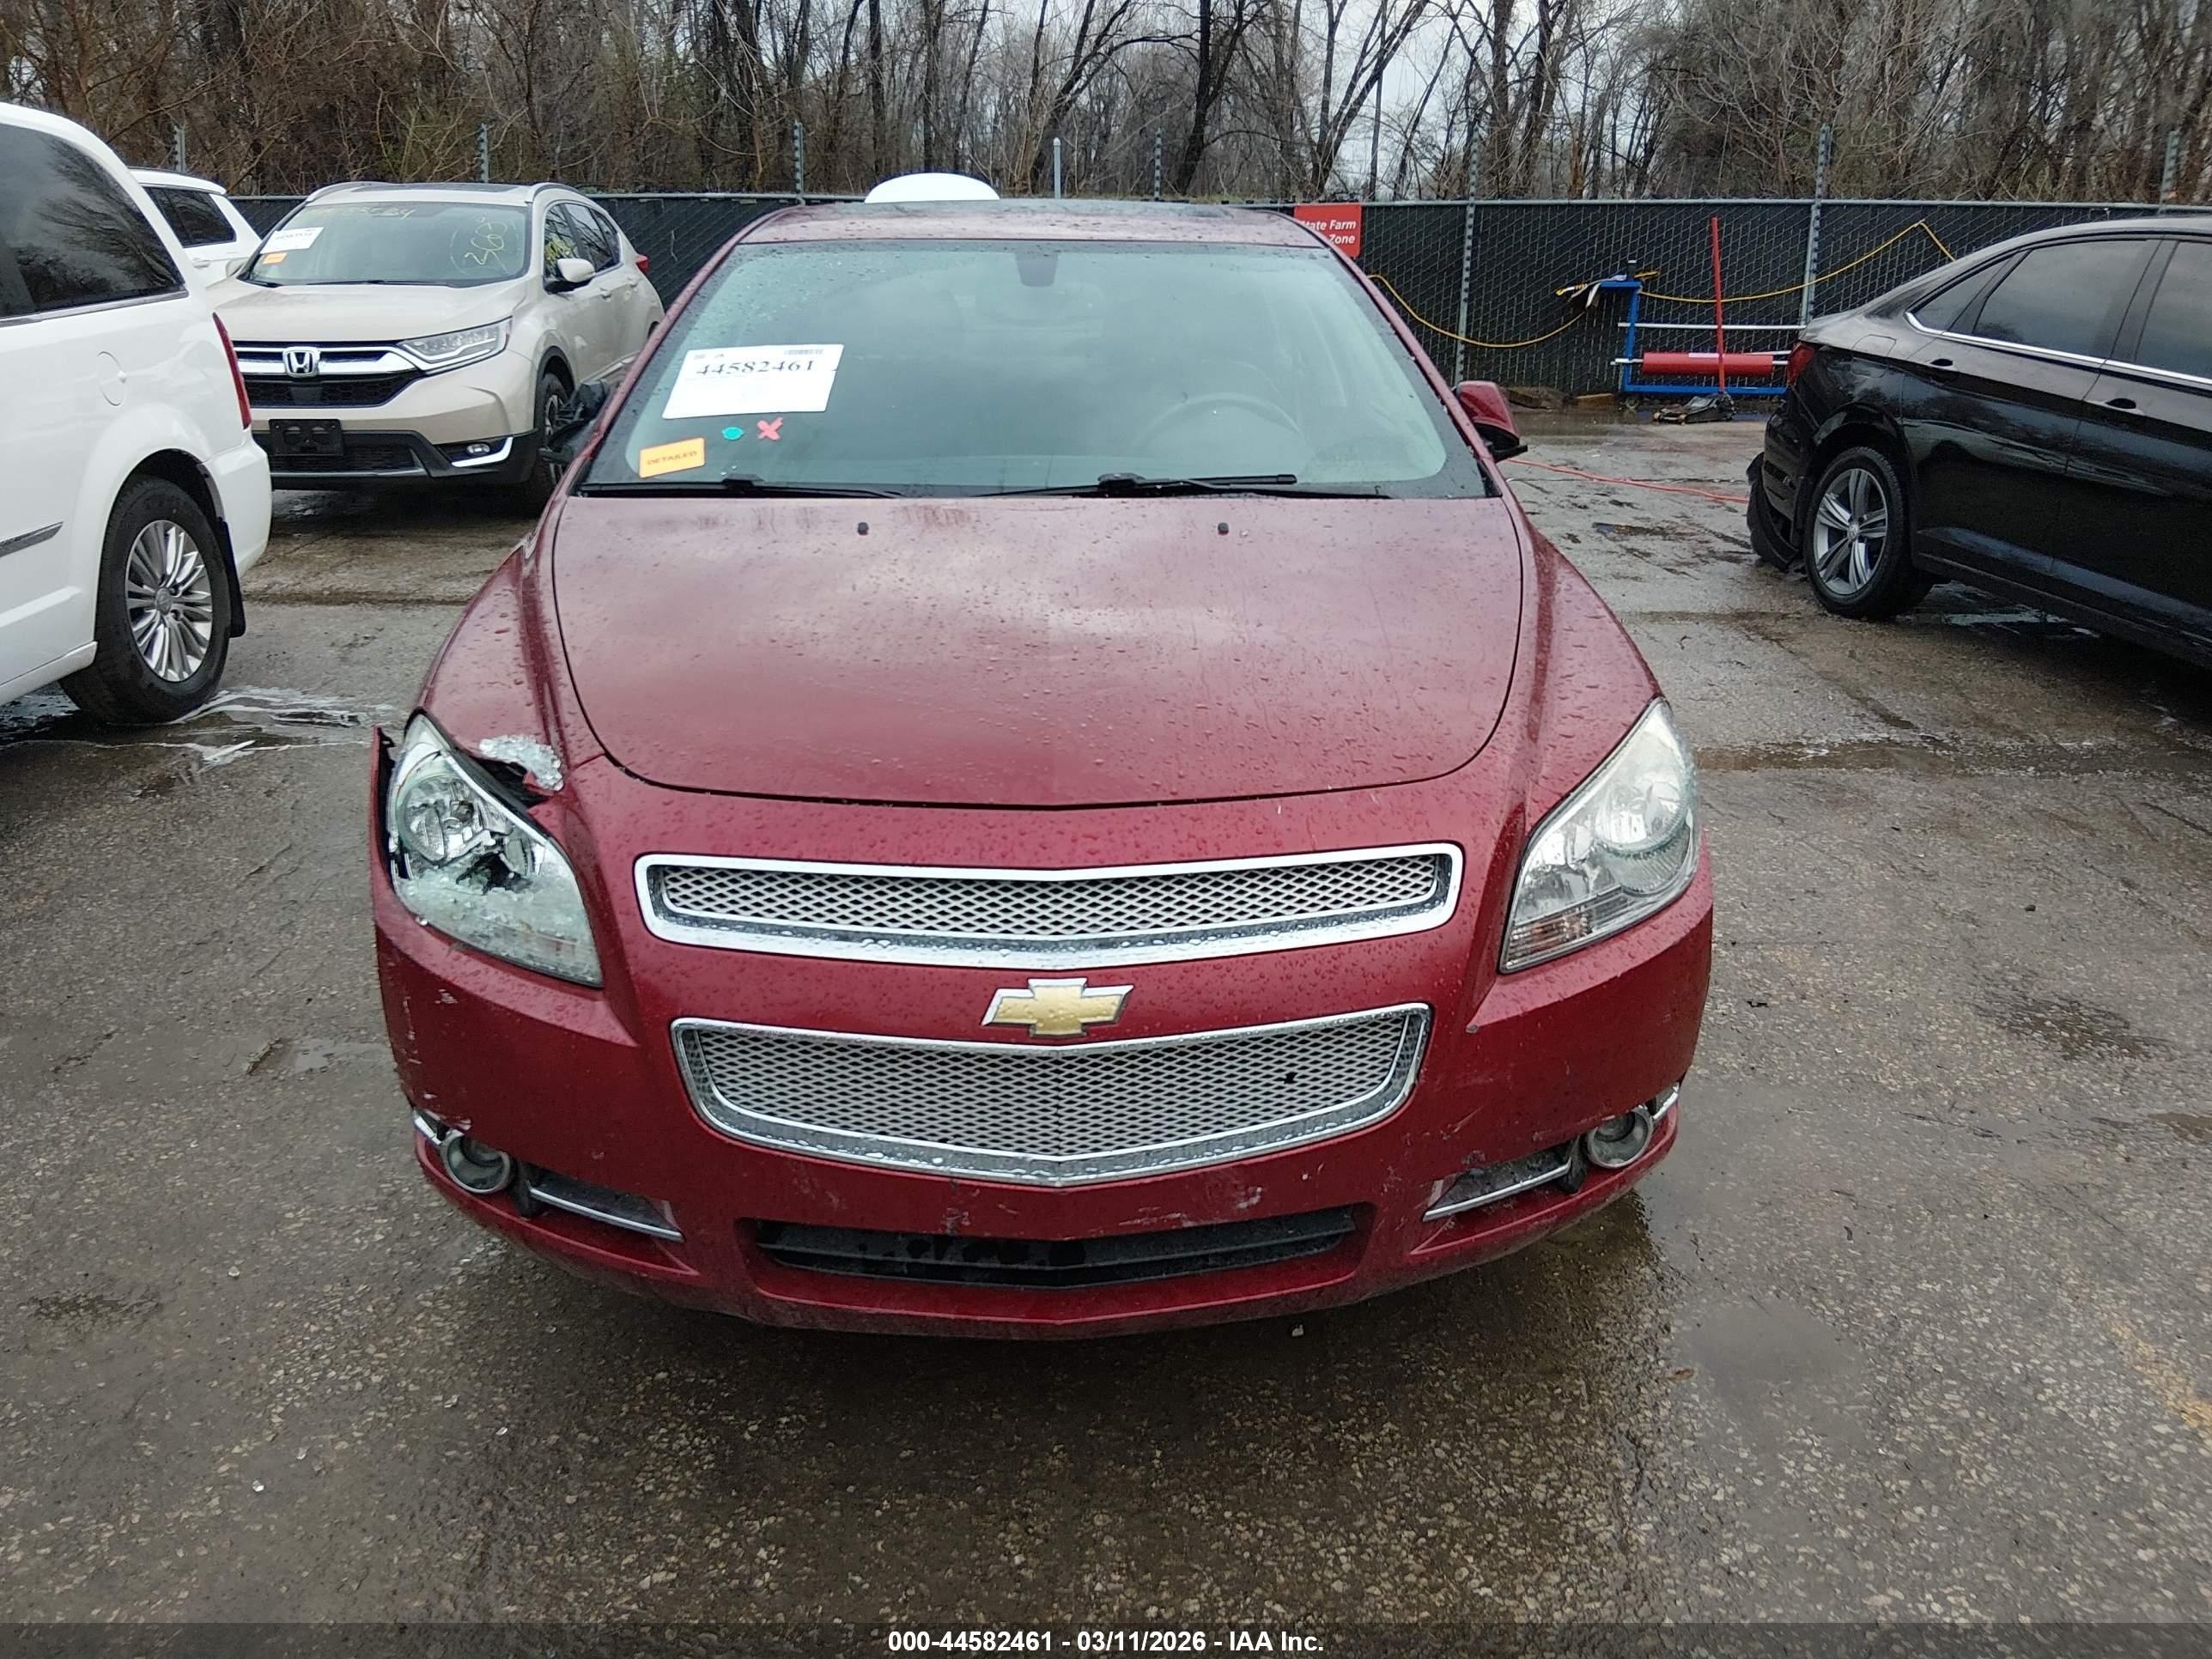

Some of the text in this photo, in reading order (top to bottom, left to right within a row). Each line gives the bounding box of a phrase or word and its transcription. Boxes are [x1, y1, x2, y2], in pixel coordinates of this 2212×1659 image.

[1329, 219, 1357, 230] Farm
[1329, 234, 1355, 244] Zone
[696, 360, 814, 374] 44582461
[647, 451, 697, 465] DETAILED
